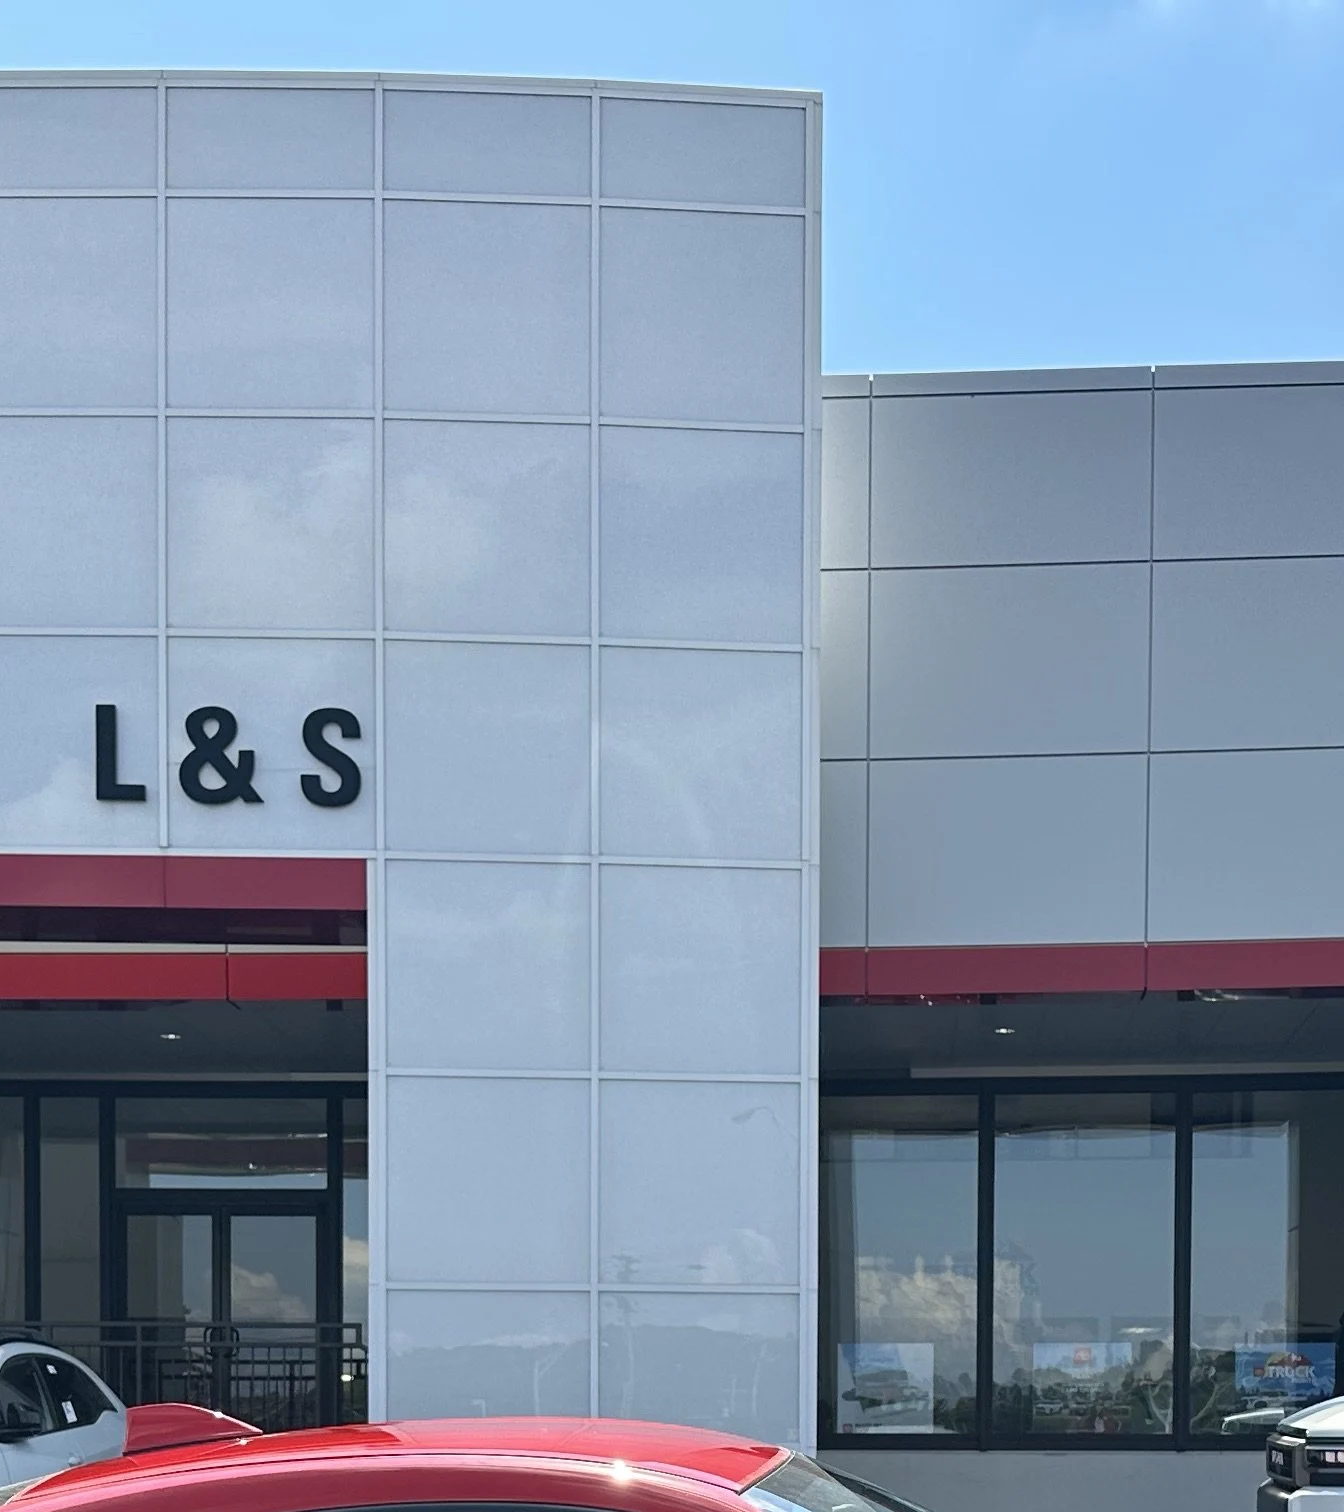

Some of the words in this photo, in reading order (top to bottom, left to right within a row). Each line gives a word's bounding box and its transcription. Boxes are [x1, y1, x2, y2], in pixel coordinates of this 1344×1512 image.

[96, 704, 146, 802] L
[179, 705, 264, 805] &
[300, 707, 362, 808] S
